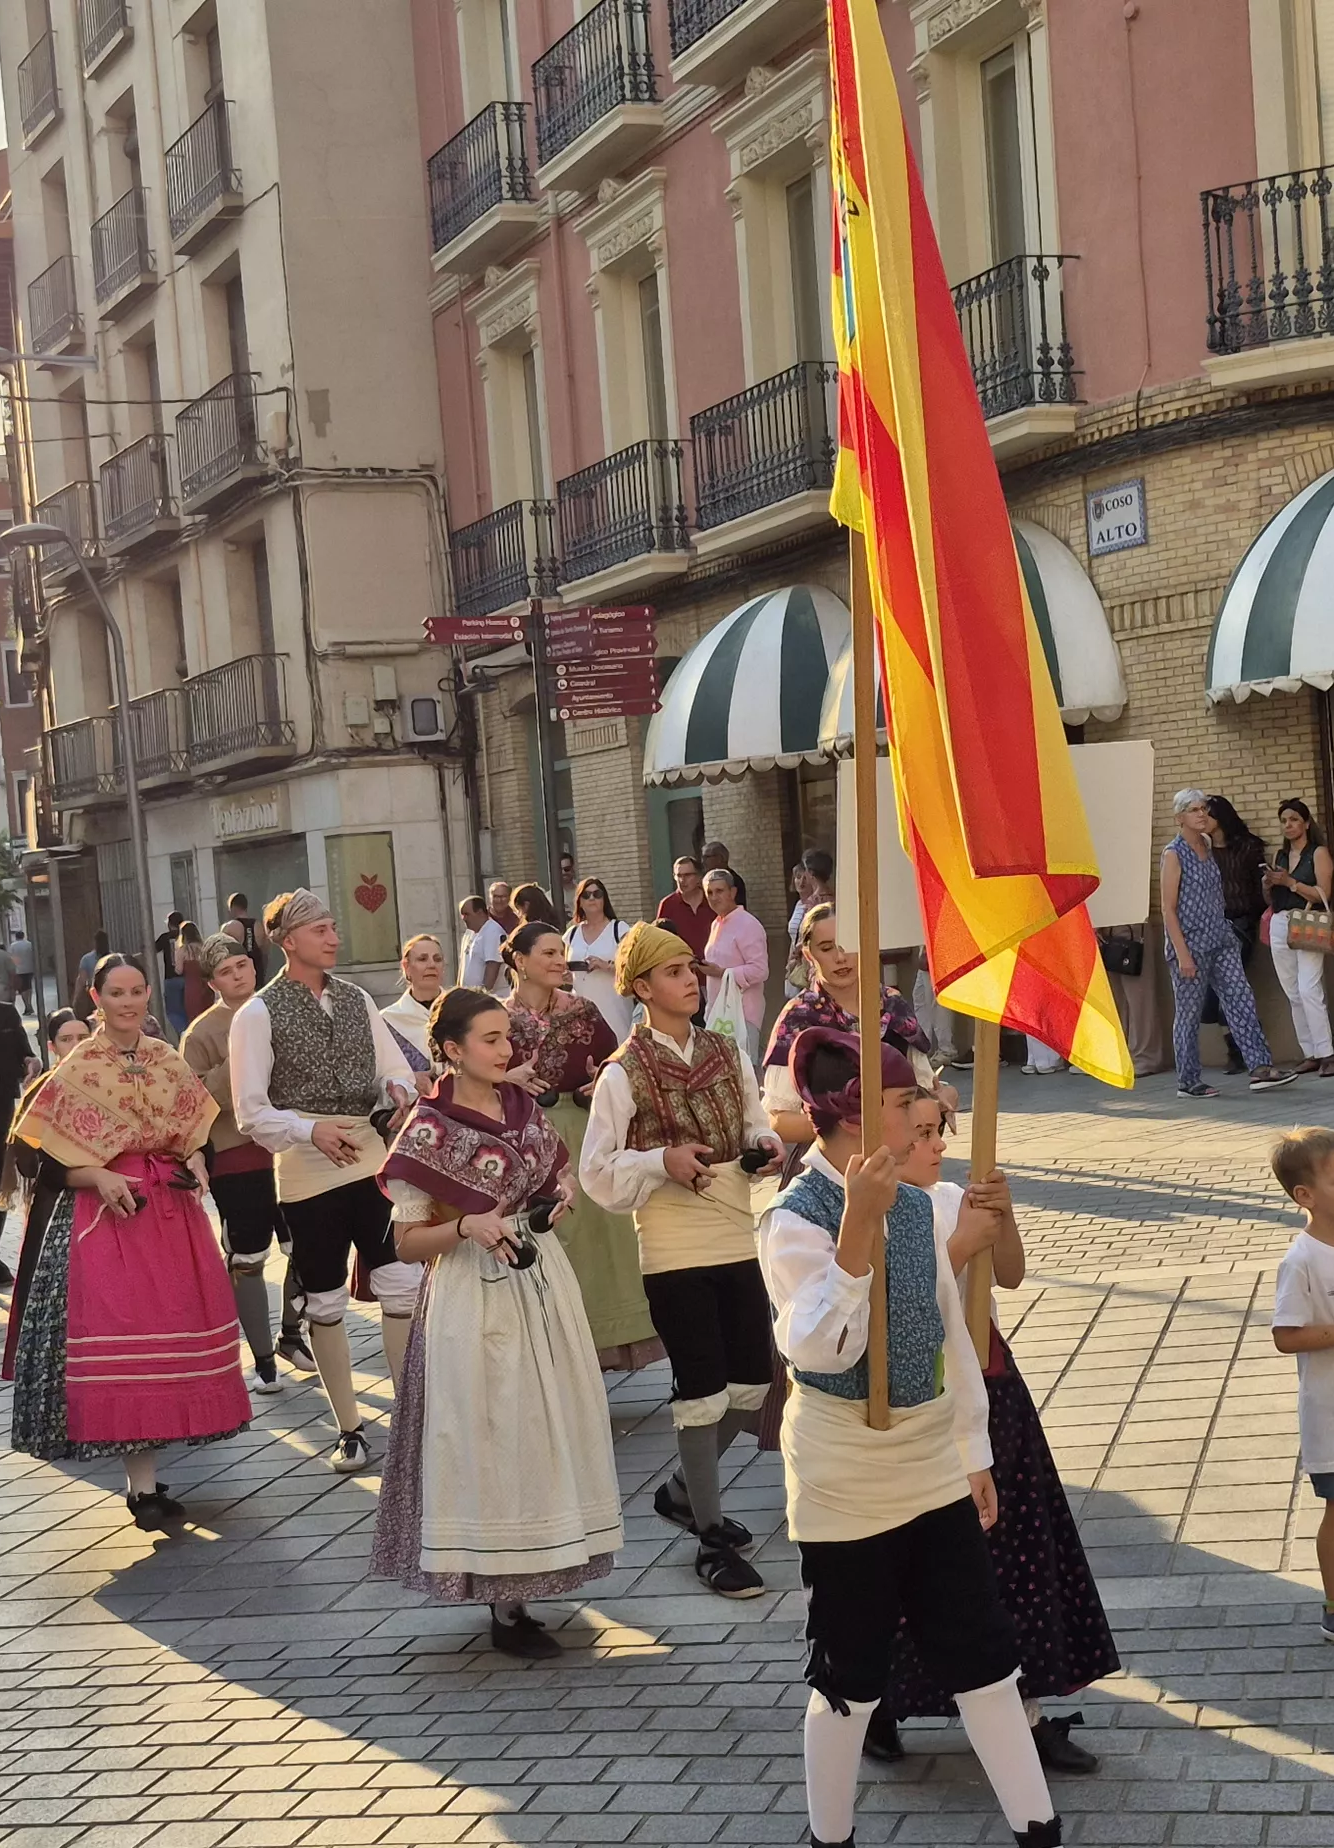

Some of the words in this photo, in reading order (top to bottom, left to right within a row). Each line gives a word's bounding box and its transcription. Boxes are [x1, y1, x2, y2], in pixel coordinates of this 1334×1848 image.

[1105, 494, 1133, 512] COSO
[1097, 522, 1137, 544] ALTO
[591, 611, 625, 619] edagógico
[462, 619, 485, 627] Parking
[610, 646, 640, 654] Provincial
[591, 663, 624, 671] Diocesano
[570, 679, 596, 687] Catedral
[572, 693, 614, 702] Ayuntamiento
[594, 706, 622, 714] Histórico
[209, 790, 278, 838] Tentazioni
